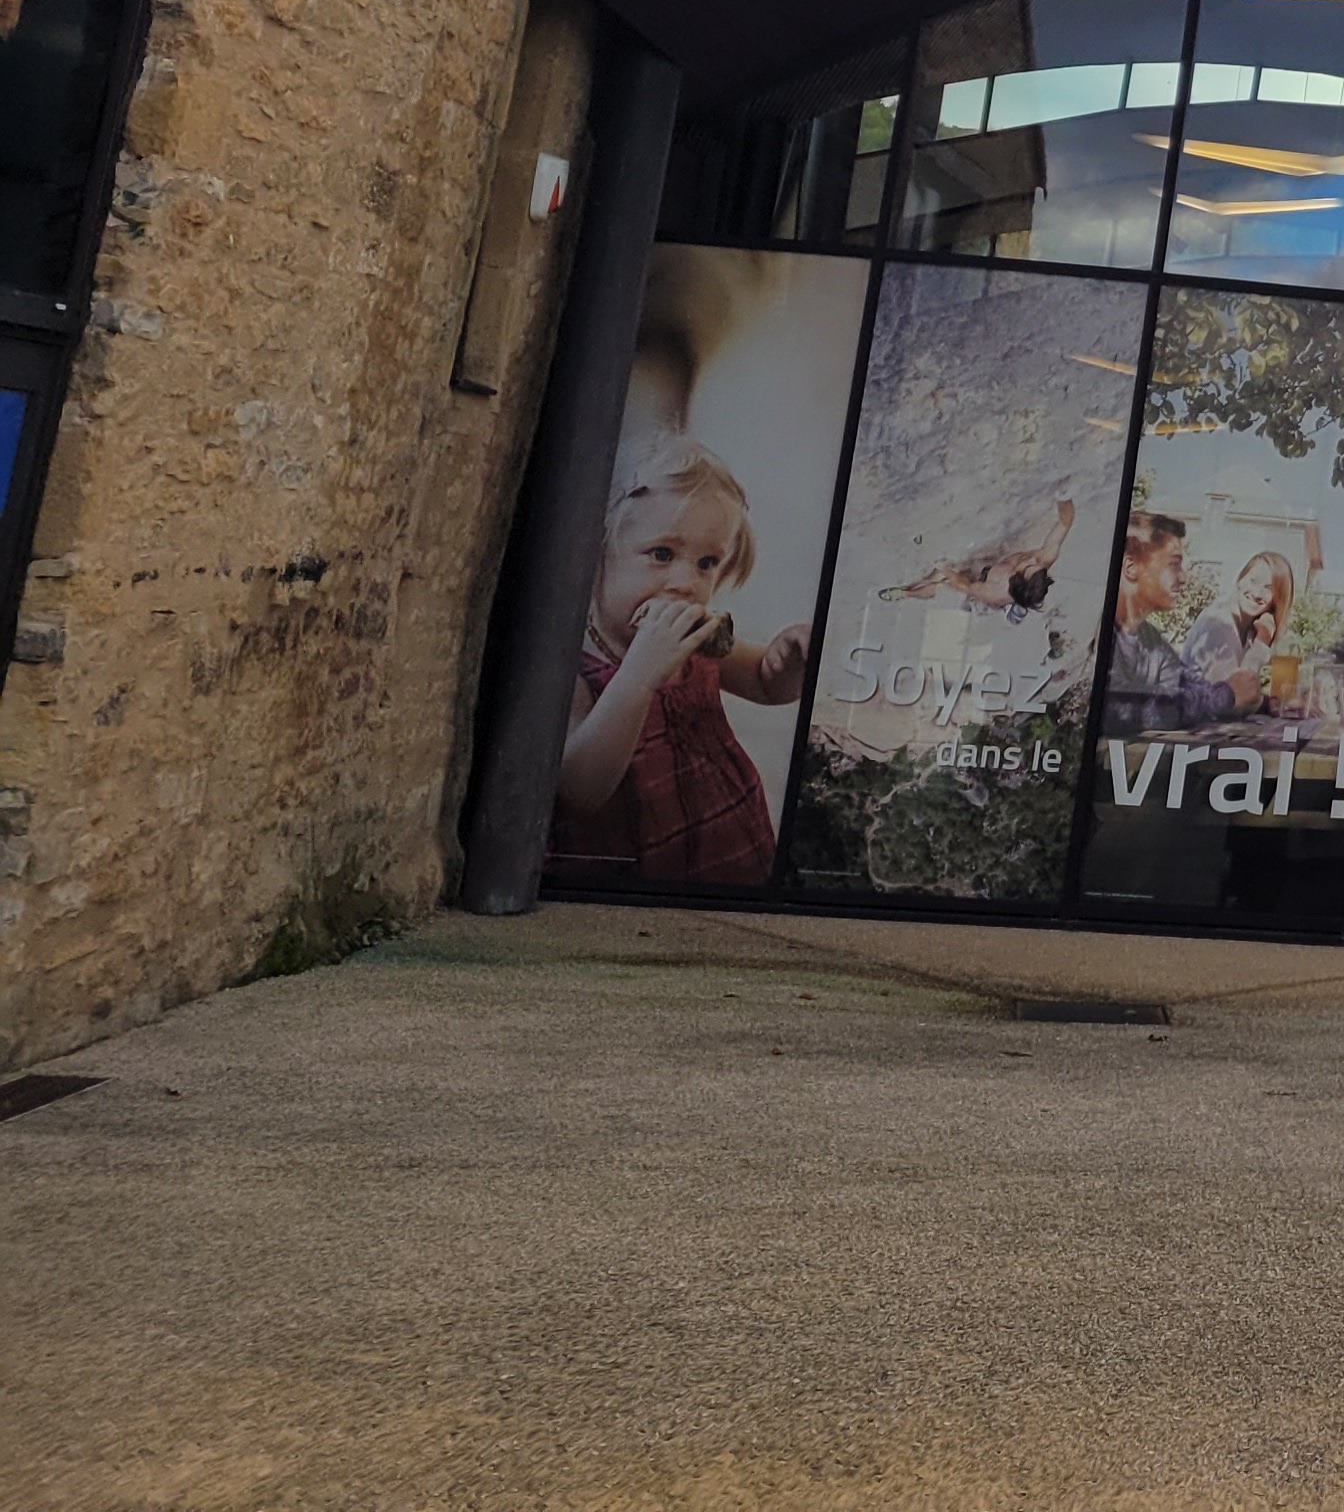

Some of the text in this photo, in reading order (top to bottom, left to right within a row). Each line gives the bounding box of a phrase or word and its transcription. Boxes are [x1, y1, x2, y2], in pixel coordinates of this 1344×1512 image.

[836, 641, 1053, 727] Soyez
[936, 737, 1062, 774] dans le
[1109, 726, 1300, 817] vrai
